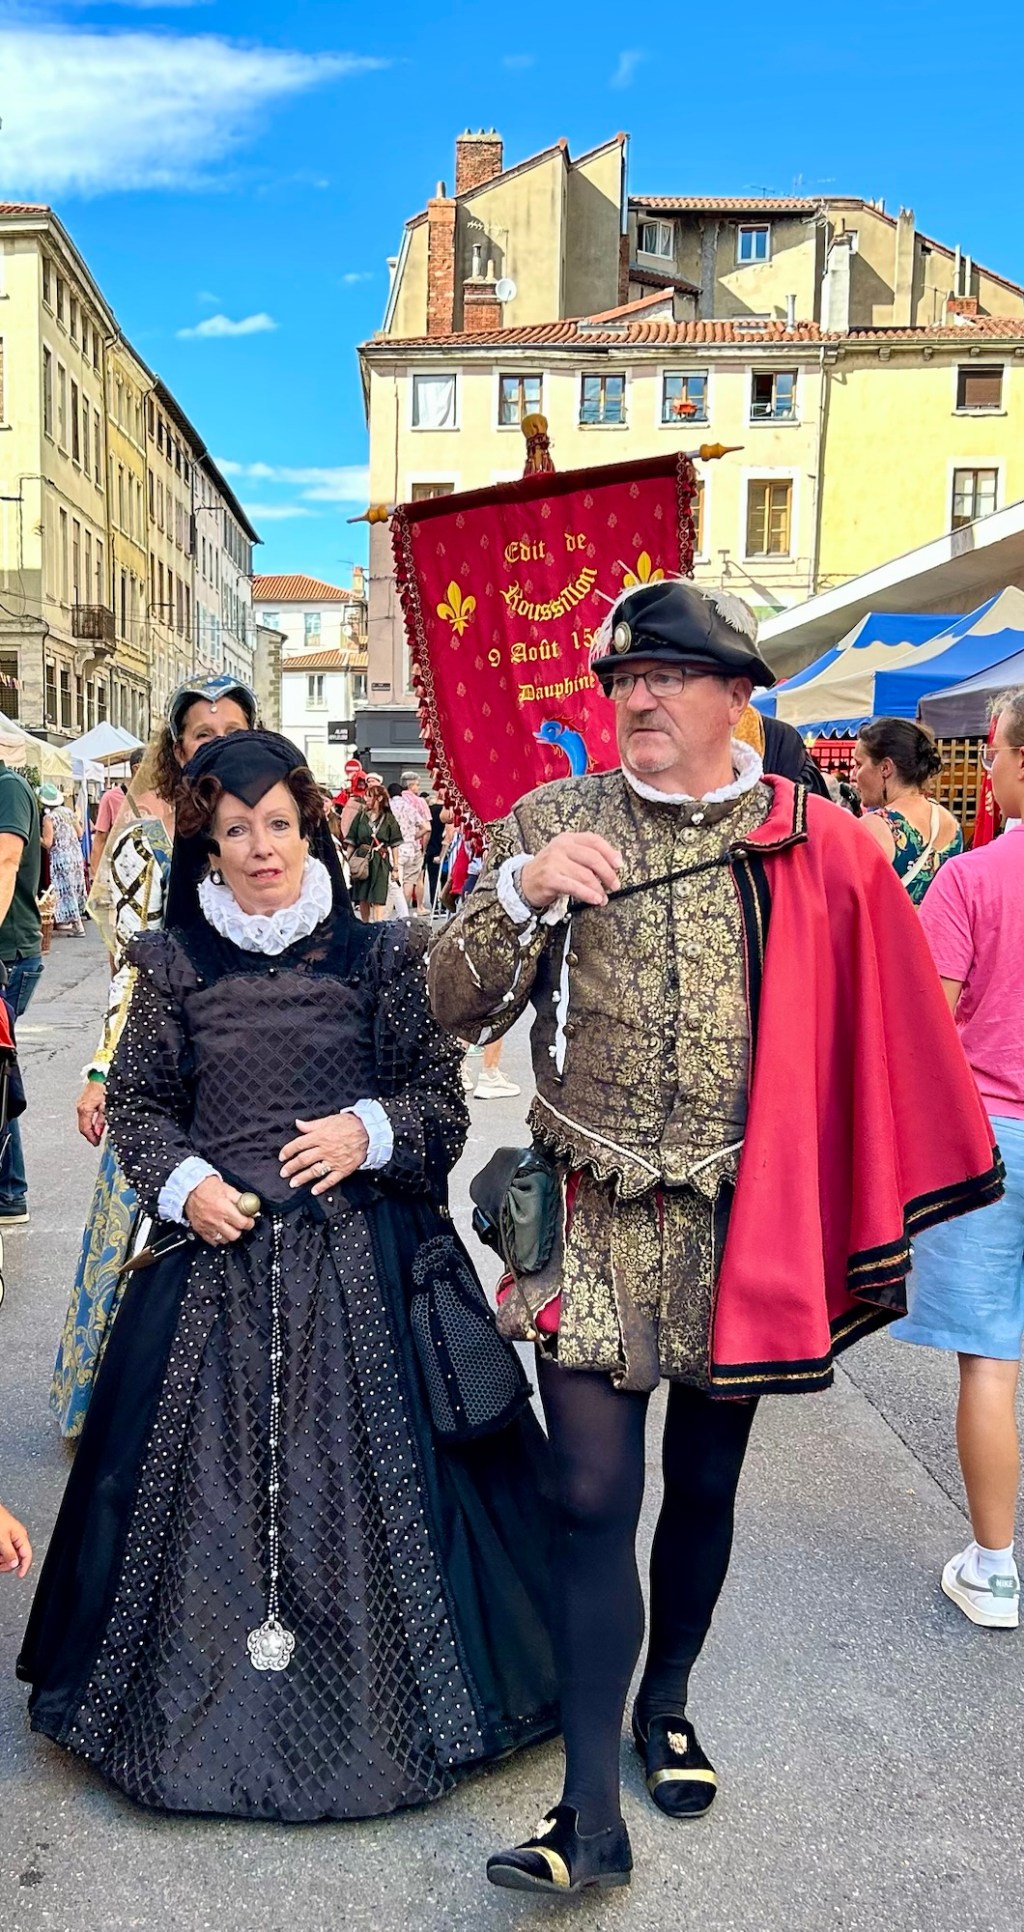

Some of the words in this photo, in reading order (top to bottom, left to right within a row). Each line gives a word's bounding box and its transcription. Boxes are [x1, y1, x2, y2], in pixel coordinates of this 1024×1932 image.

[504, 540, 546, 563] Edit
[565, 532, 587, 552] de
[499, 566, 598, 622] Roussillon
[488, 648, 501, 667] 9
[510, 638, 560, 665] Août
[995, 1579, 1014, 1588] NIKE
